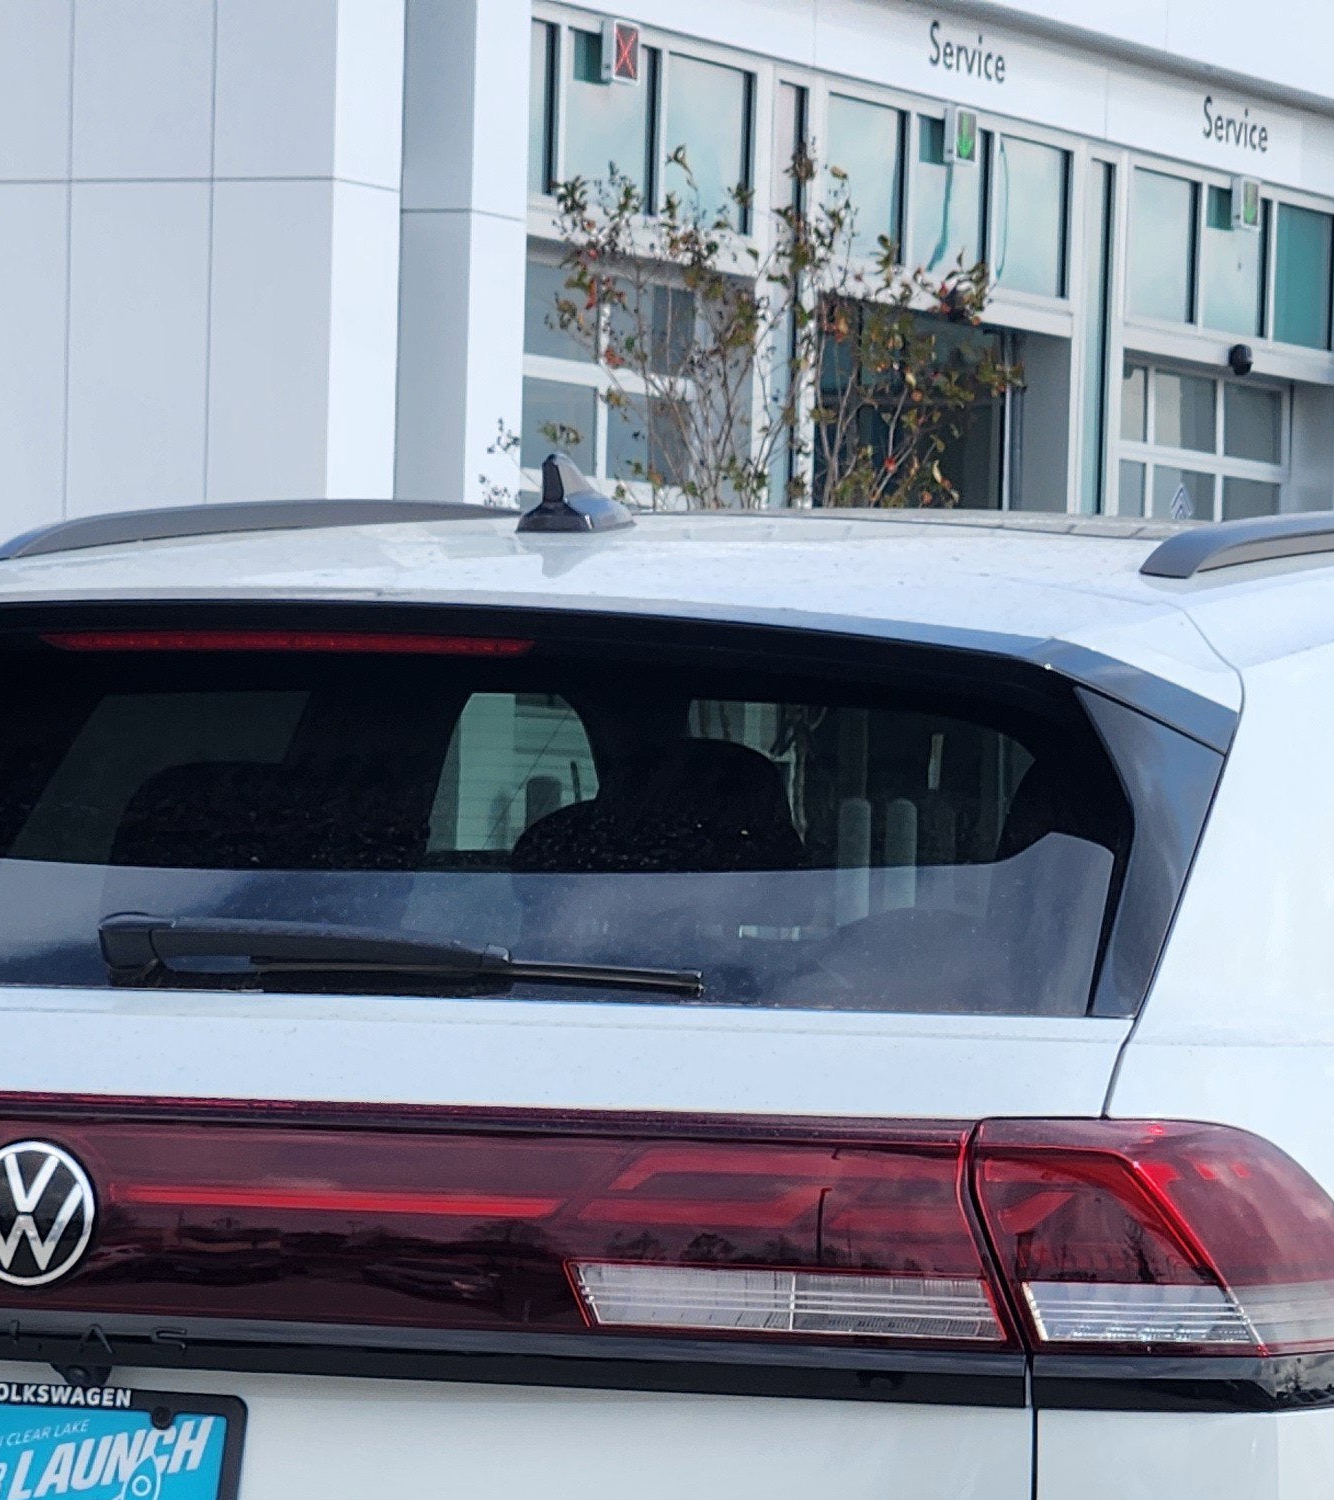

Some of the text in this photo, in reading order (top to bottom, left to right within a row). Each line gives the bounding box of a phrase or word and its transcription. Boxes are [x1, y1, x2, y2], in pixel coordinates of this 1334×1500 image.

[929, 20, 1005, 83] Service
[1202, 95, 1268, 153] Service
[6, 1427, 52, 1447] CLEAR
[53, 1418, 91, 1438] LAKE
